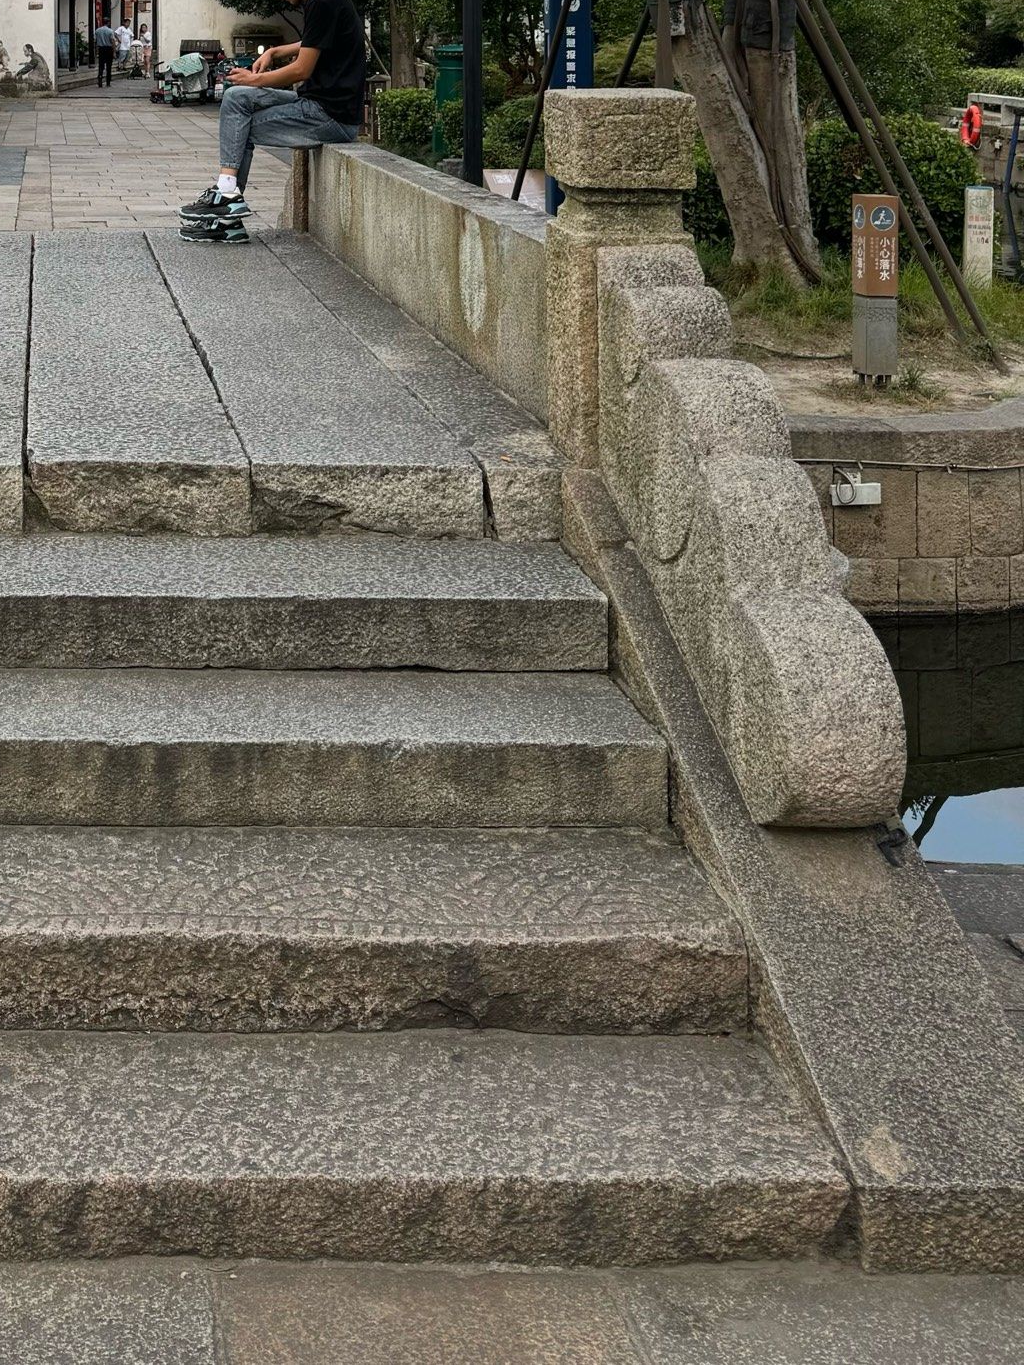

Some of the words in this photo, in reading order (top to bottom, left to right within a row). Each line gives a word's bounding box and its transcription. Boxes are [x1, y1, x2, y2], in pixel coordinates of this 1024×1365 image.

[566, 26, 576, 89] 紧急报警求
[879, 237, 890, 281] 小心落水
